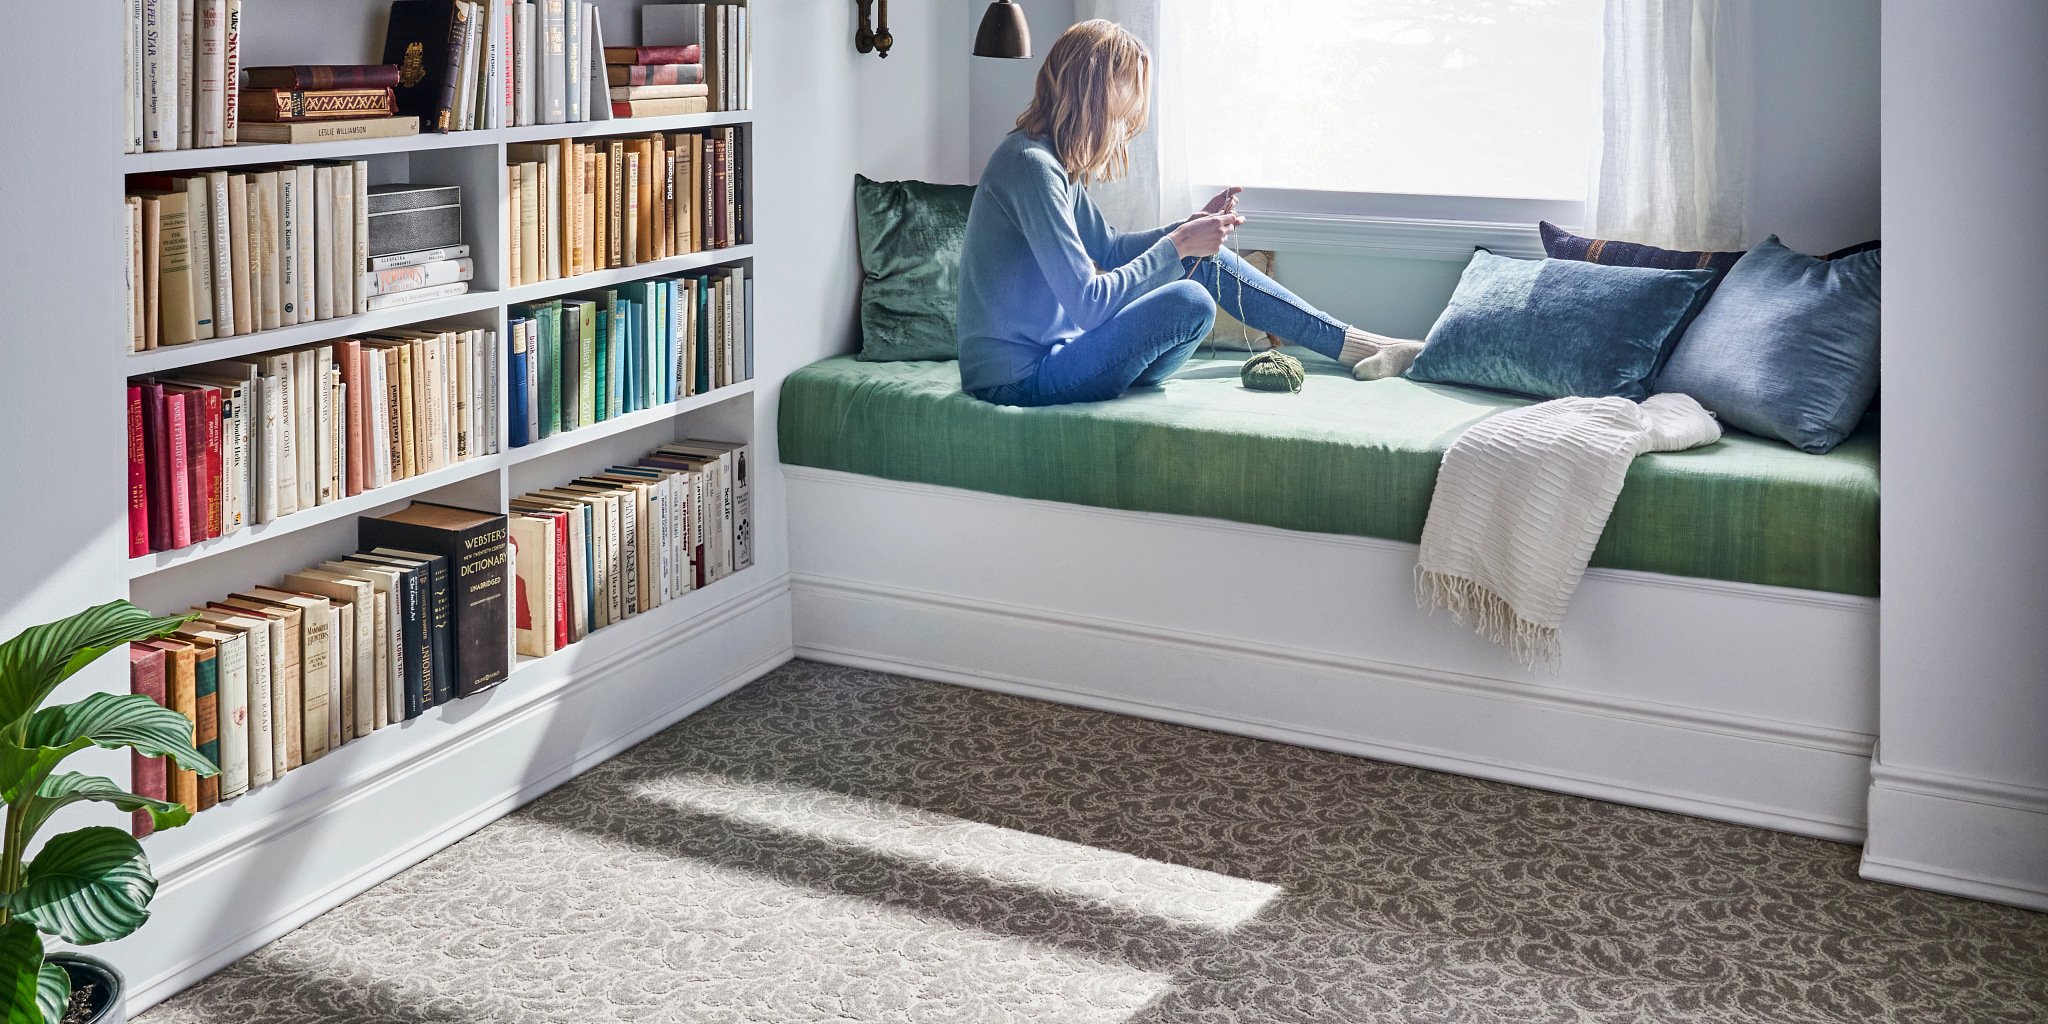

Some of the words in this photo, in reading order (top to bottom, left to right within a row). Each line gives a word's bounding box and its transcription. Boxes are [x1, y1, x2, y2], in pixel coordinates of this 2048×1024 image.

[231, 8, 239, 31] Adler
[147, 30, 157, 56] STAR
[229, 33, 238, 54] Six
[491, 44, 497, 52] BY
[149, 63, 157, 95] Mary-Rose
[227, 55, 237, 91] Great
[227, 94, 236, 129] Ideas
[318, 128, 334, 136] LESLIE
[336, 126, 366, 135] WILLIAMSON
[215, 181, 227, 232] MOMMIE
[285, 220, 291, 228] &
[218, 233, 228, 283] DEAREST
[583, 338, 591, 366] Italian
[280, 362, 288, 371] IF
[583, 368, 591, 399] Wines
[281, 374, 289, 426] TOMORROW
[583, 401, 591, 422] 2017
[624, 498, 636, 547] MATTHEW
[464, 527, 506, 550] WEBSTER'S
[461, 551, 508, 577] DICTIONARY
[626, 549, 636, 595] ARNOLD
[469, 576, 502, 593] UNABRIDGED
[307, 632, 329, 646] HUNTERS
[260, 653, 268, 700] TOKAIDO
[421, 645, 431, 704] FLASHPOINT
